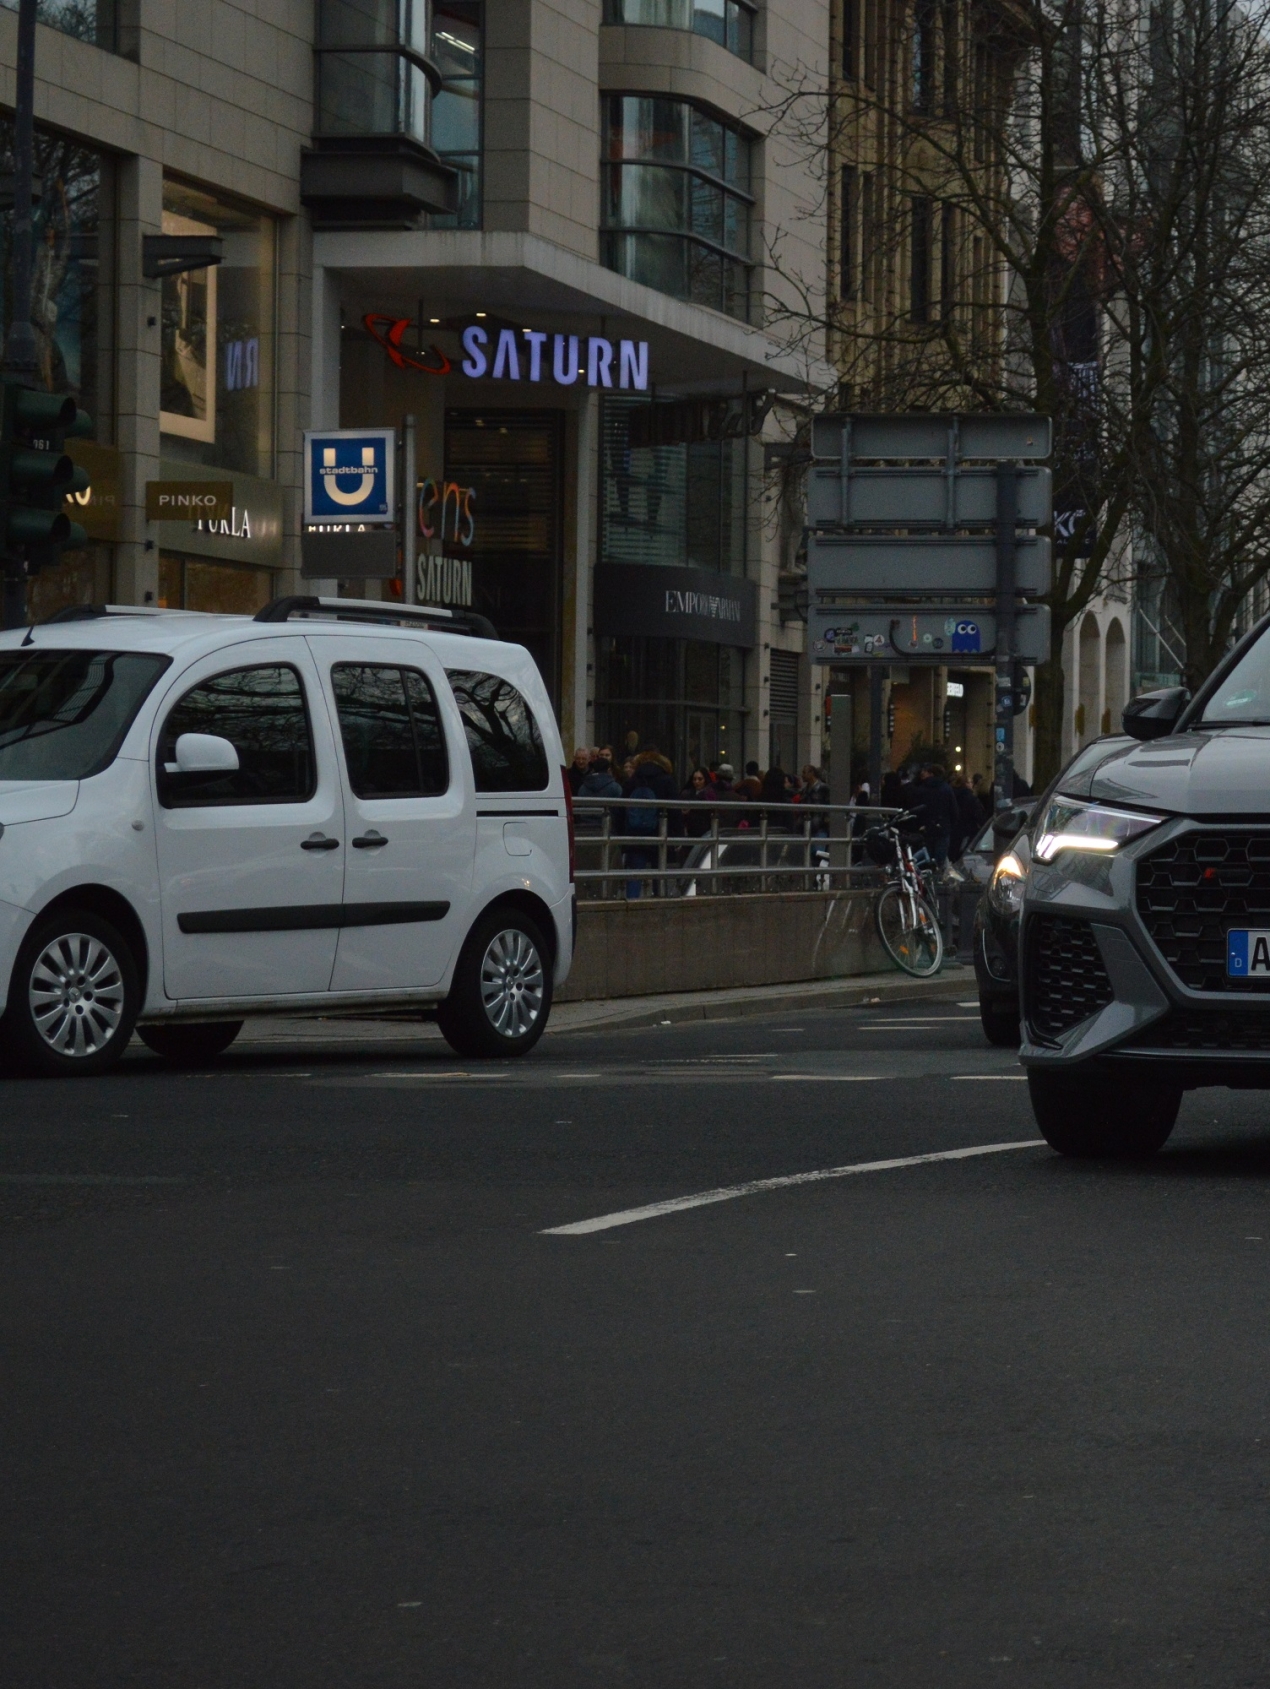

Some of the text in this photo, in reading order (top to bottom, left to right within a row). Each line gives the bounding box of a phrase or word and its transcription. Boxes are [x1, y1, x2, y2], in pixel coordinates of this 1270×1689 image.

[462, 325, 649, 391] SATURN
[319, 465, 379, 476] stadtbahn
[158, 494, 217, 506] PINKO
[416, 552, 472, 607] SATURN
